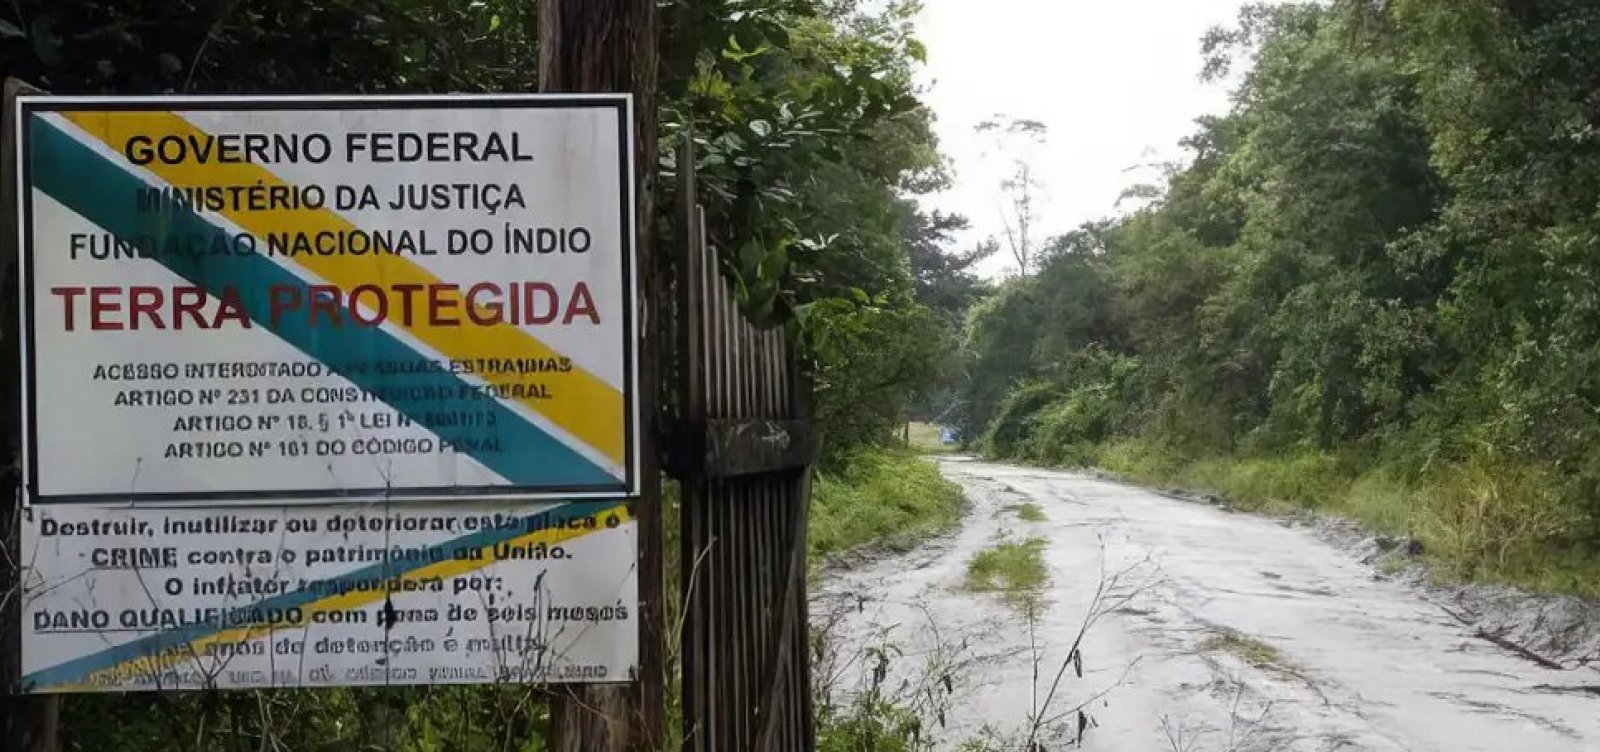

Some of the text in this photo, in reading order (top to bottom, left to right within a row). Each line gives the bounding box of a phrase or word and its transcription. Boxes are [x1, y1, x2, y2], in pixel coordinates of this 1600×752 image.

[125, 131, 533, 165] GOVERNO FEDERAL
[136, 179, 526, 215] MINISTÉRIO DA JUSTIÇA
[70, 222, 591, 259] FUNDAÇÃO NACIONAL DO ÍNDIO
[51, 281, 600, 332] TERRA PROTEGIDA
[114, 390, 194, 406] ARTIGO
[227, 389, 259, 404] 231
[266, 388, 295, 404] DA
[173, 416, 253, 432] ARTIGO
[360, 412, 391, 428] LEI
[164, 442, 244, 459] ARTIGO
[316, 440, 346, 456] DO
[351, 436, 433, 455] CÓDIGO
[285, 518, 318, 533] ou
[165, 578, 183, 595] O
[34, 609, 110, 631] DANO
